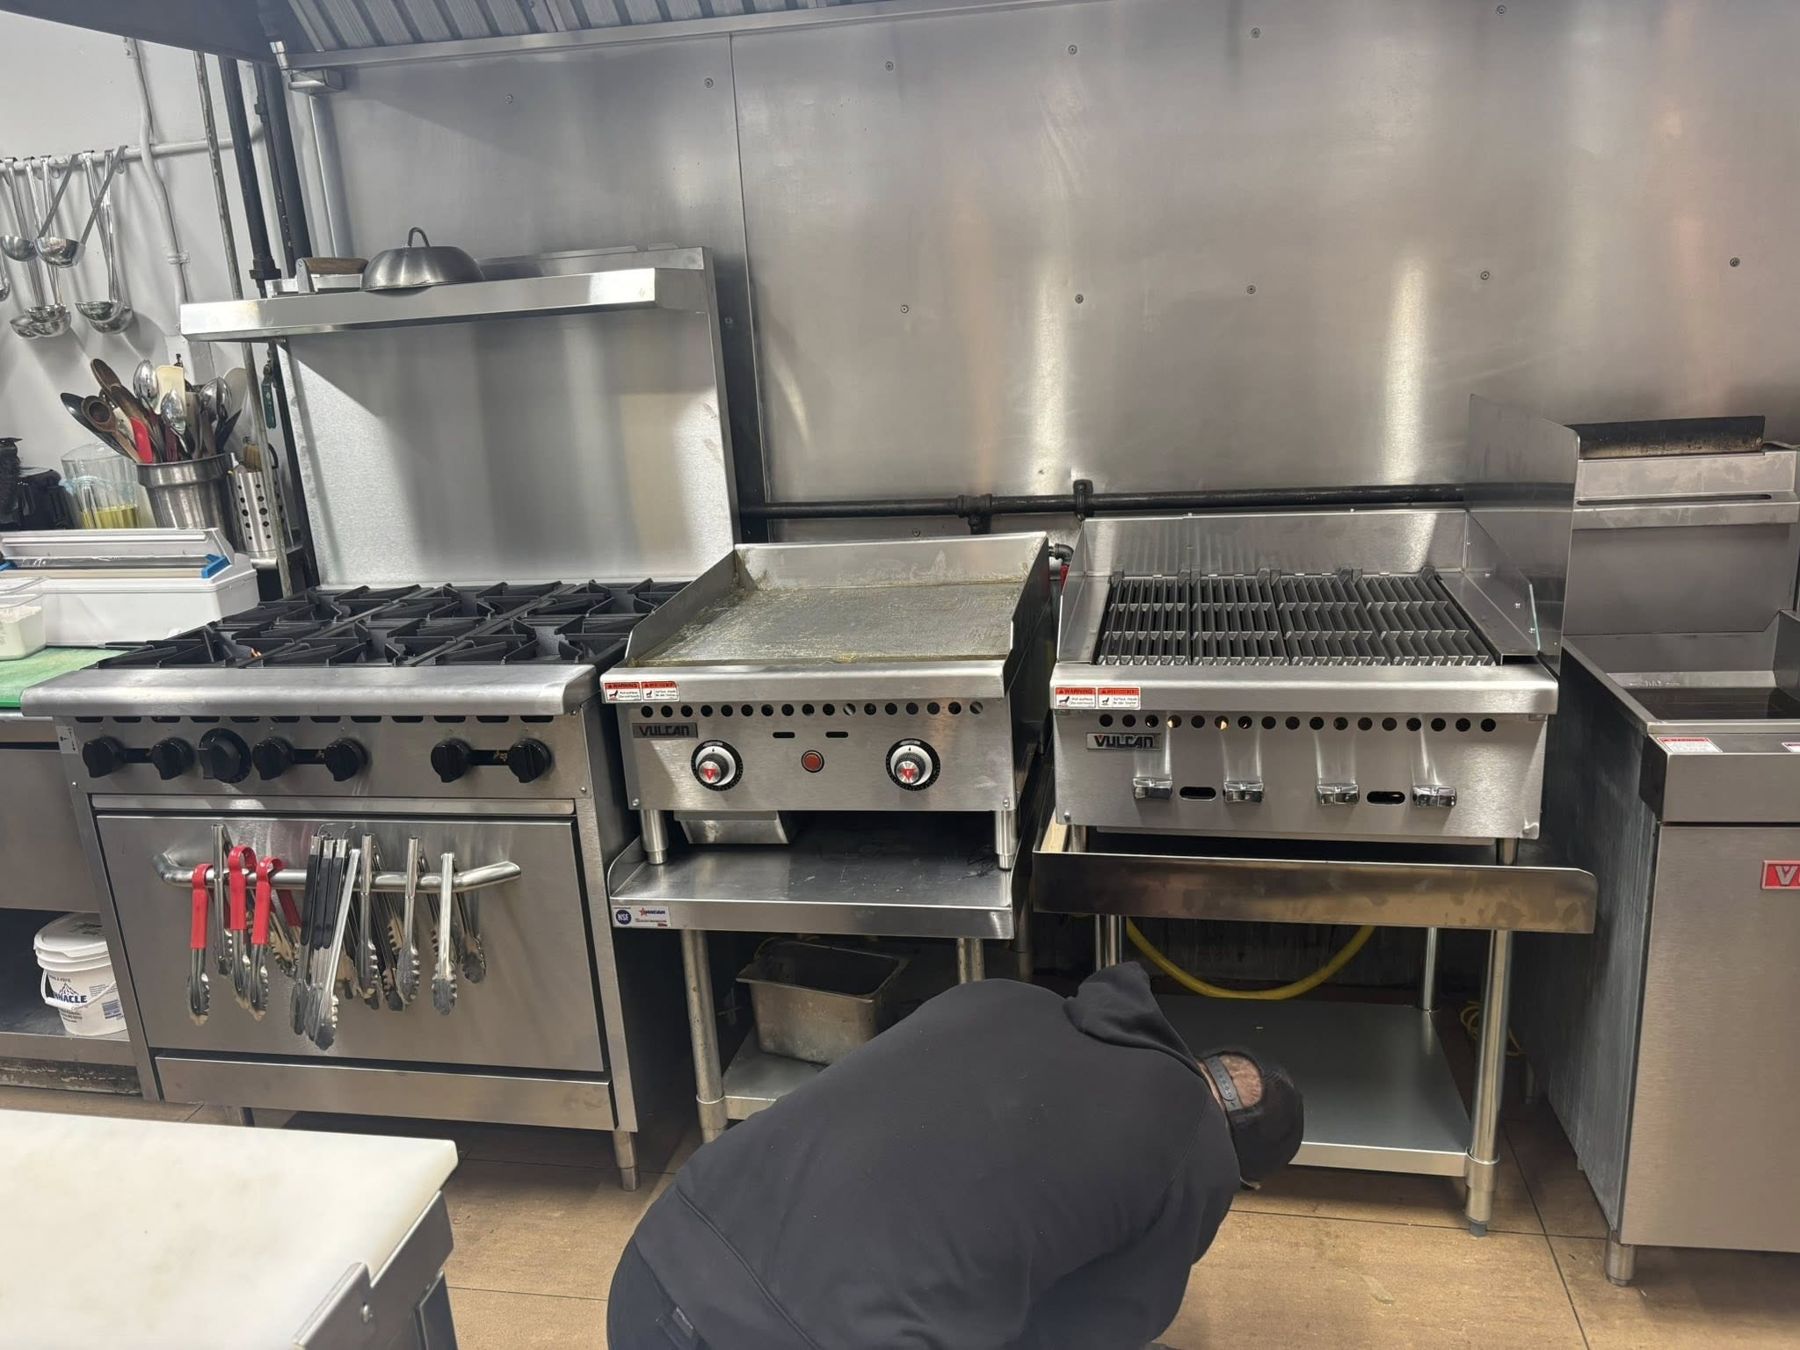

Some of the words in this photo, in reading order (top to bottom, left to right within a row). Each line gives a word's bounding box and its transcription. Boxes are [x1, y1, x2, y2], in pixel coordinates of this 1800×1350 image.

[639, 725, 689, 737] VULCAN
[1093, 733, 1154, 749] VULCAN
[1775, 865, 1800, 886] V
